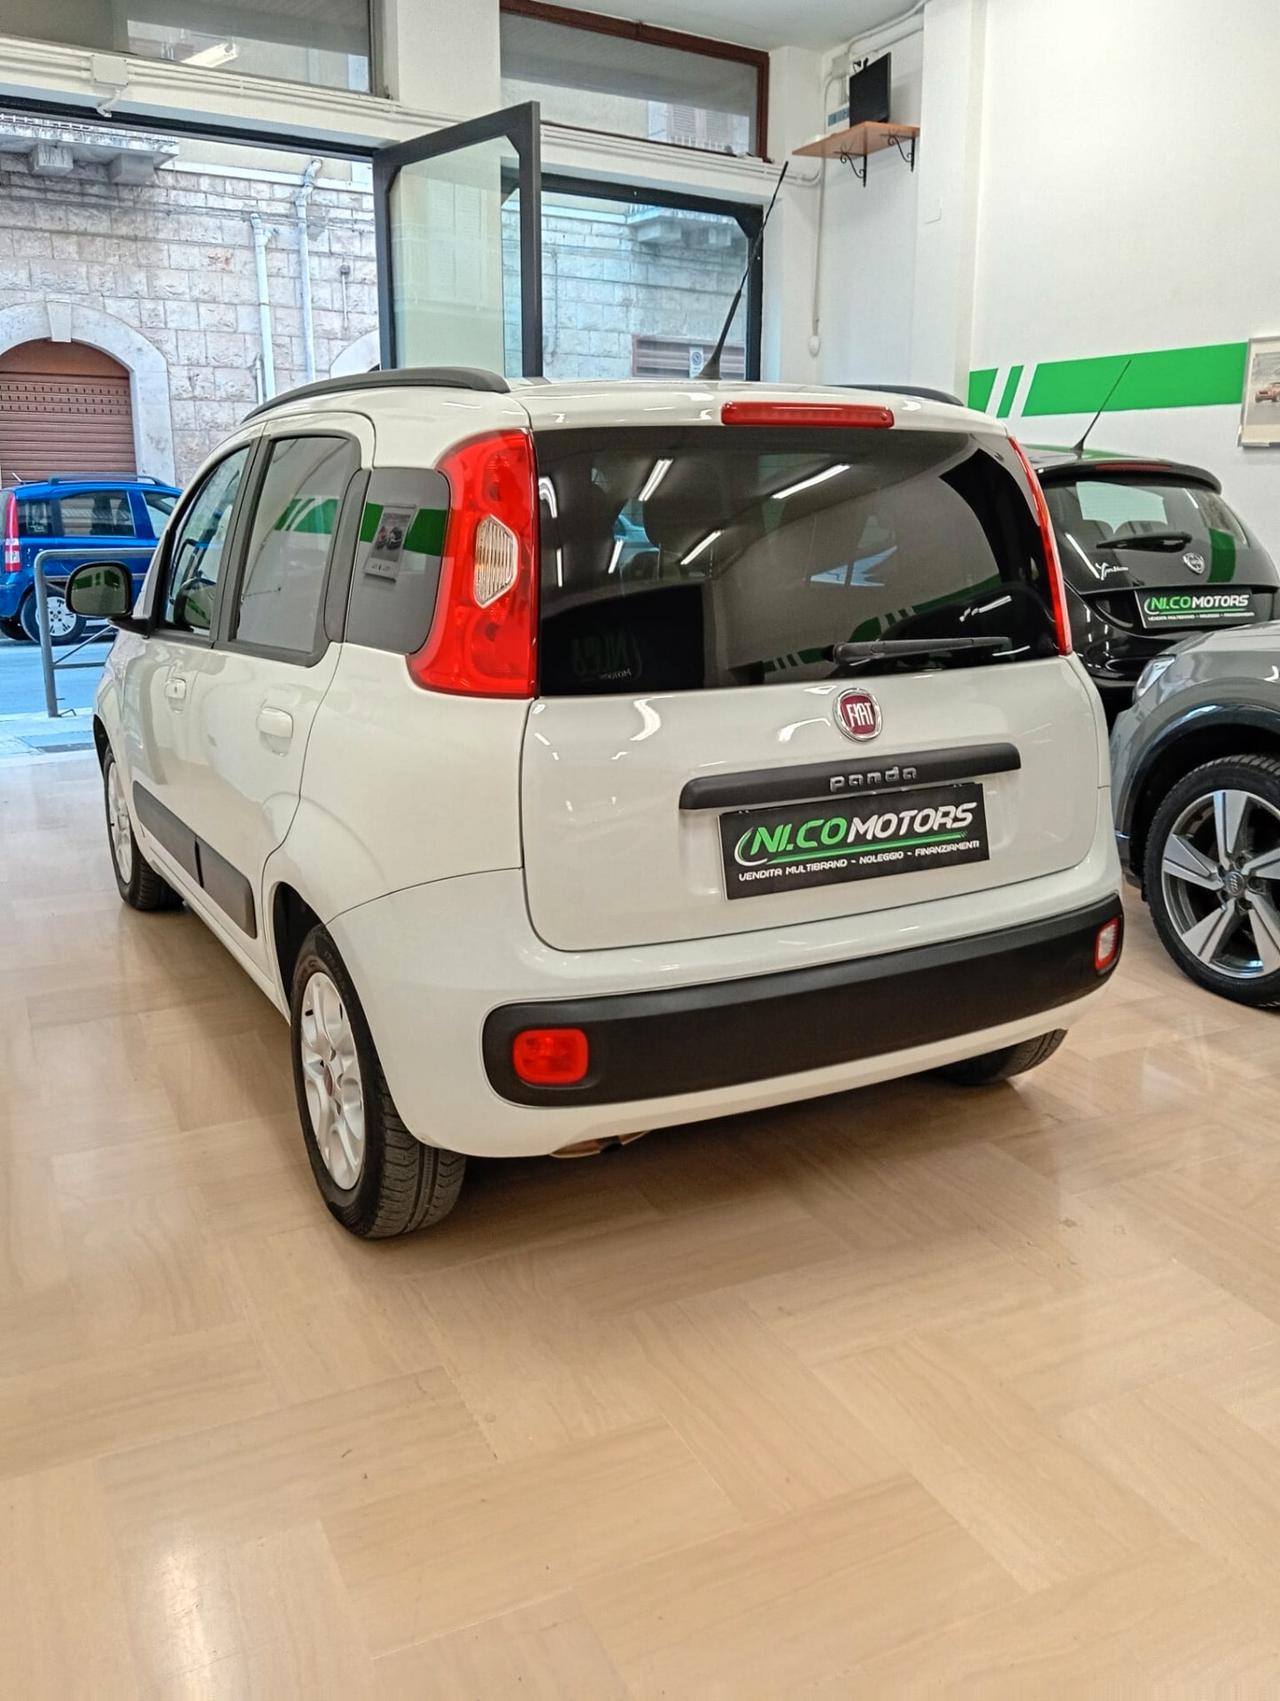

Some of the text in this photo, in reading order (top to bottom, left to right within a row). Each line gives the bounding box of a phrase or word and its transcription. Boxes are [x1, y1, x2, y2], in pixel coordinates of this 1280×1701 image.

[846, 702, 874, 728] FIAT
[829, 766, 917, 792] panda
[738, 867, 782, 881] VENDITA
[785, 859, 848, 875] MULTIBRAND
[859, 851, 904, 865] NOLEGGIO
[915, 840, 980, 857] FINANZIAMENTI
